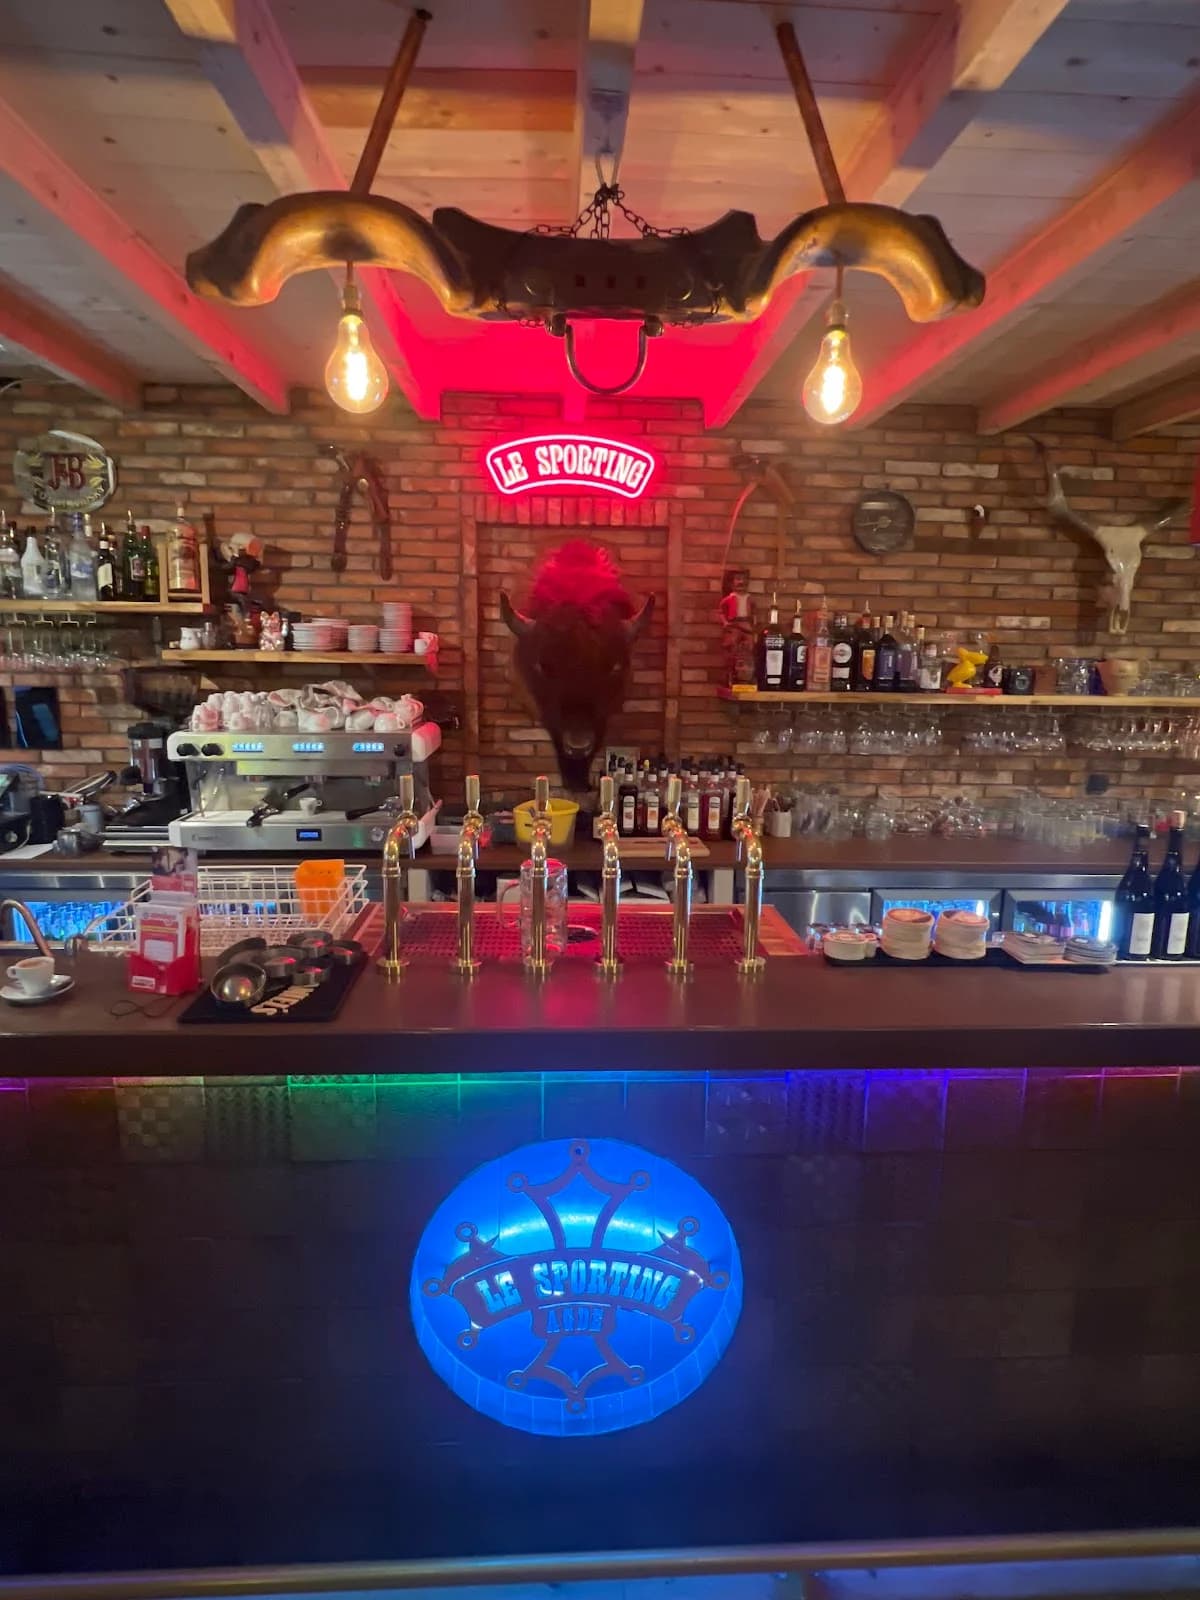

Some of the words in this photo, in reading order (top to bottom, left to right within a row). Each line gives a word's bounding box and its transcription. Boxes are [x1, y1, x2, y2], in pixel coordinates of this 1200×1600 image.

[493, 451, 529, 487] LE
[535, 444, 647, 489] SPORTING
[476, 1271, 522, 1314] LE
[532, 1259, 681, 1310] SPORTING
